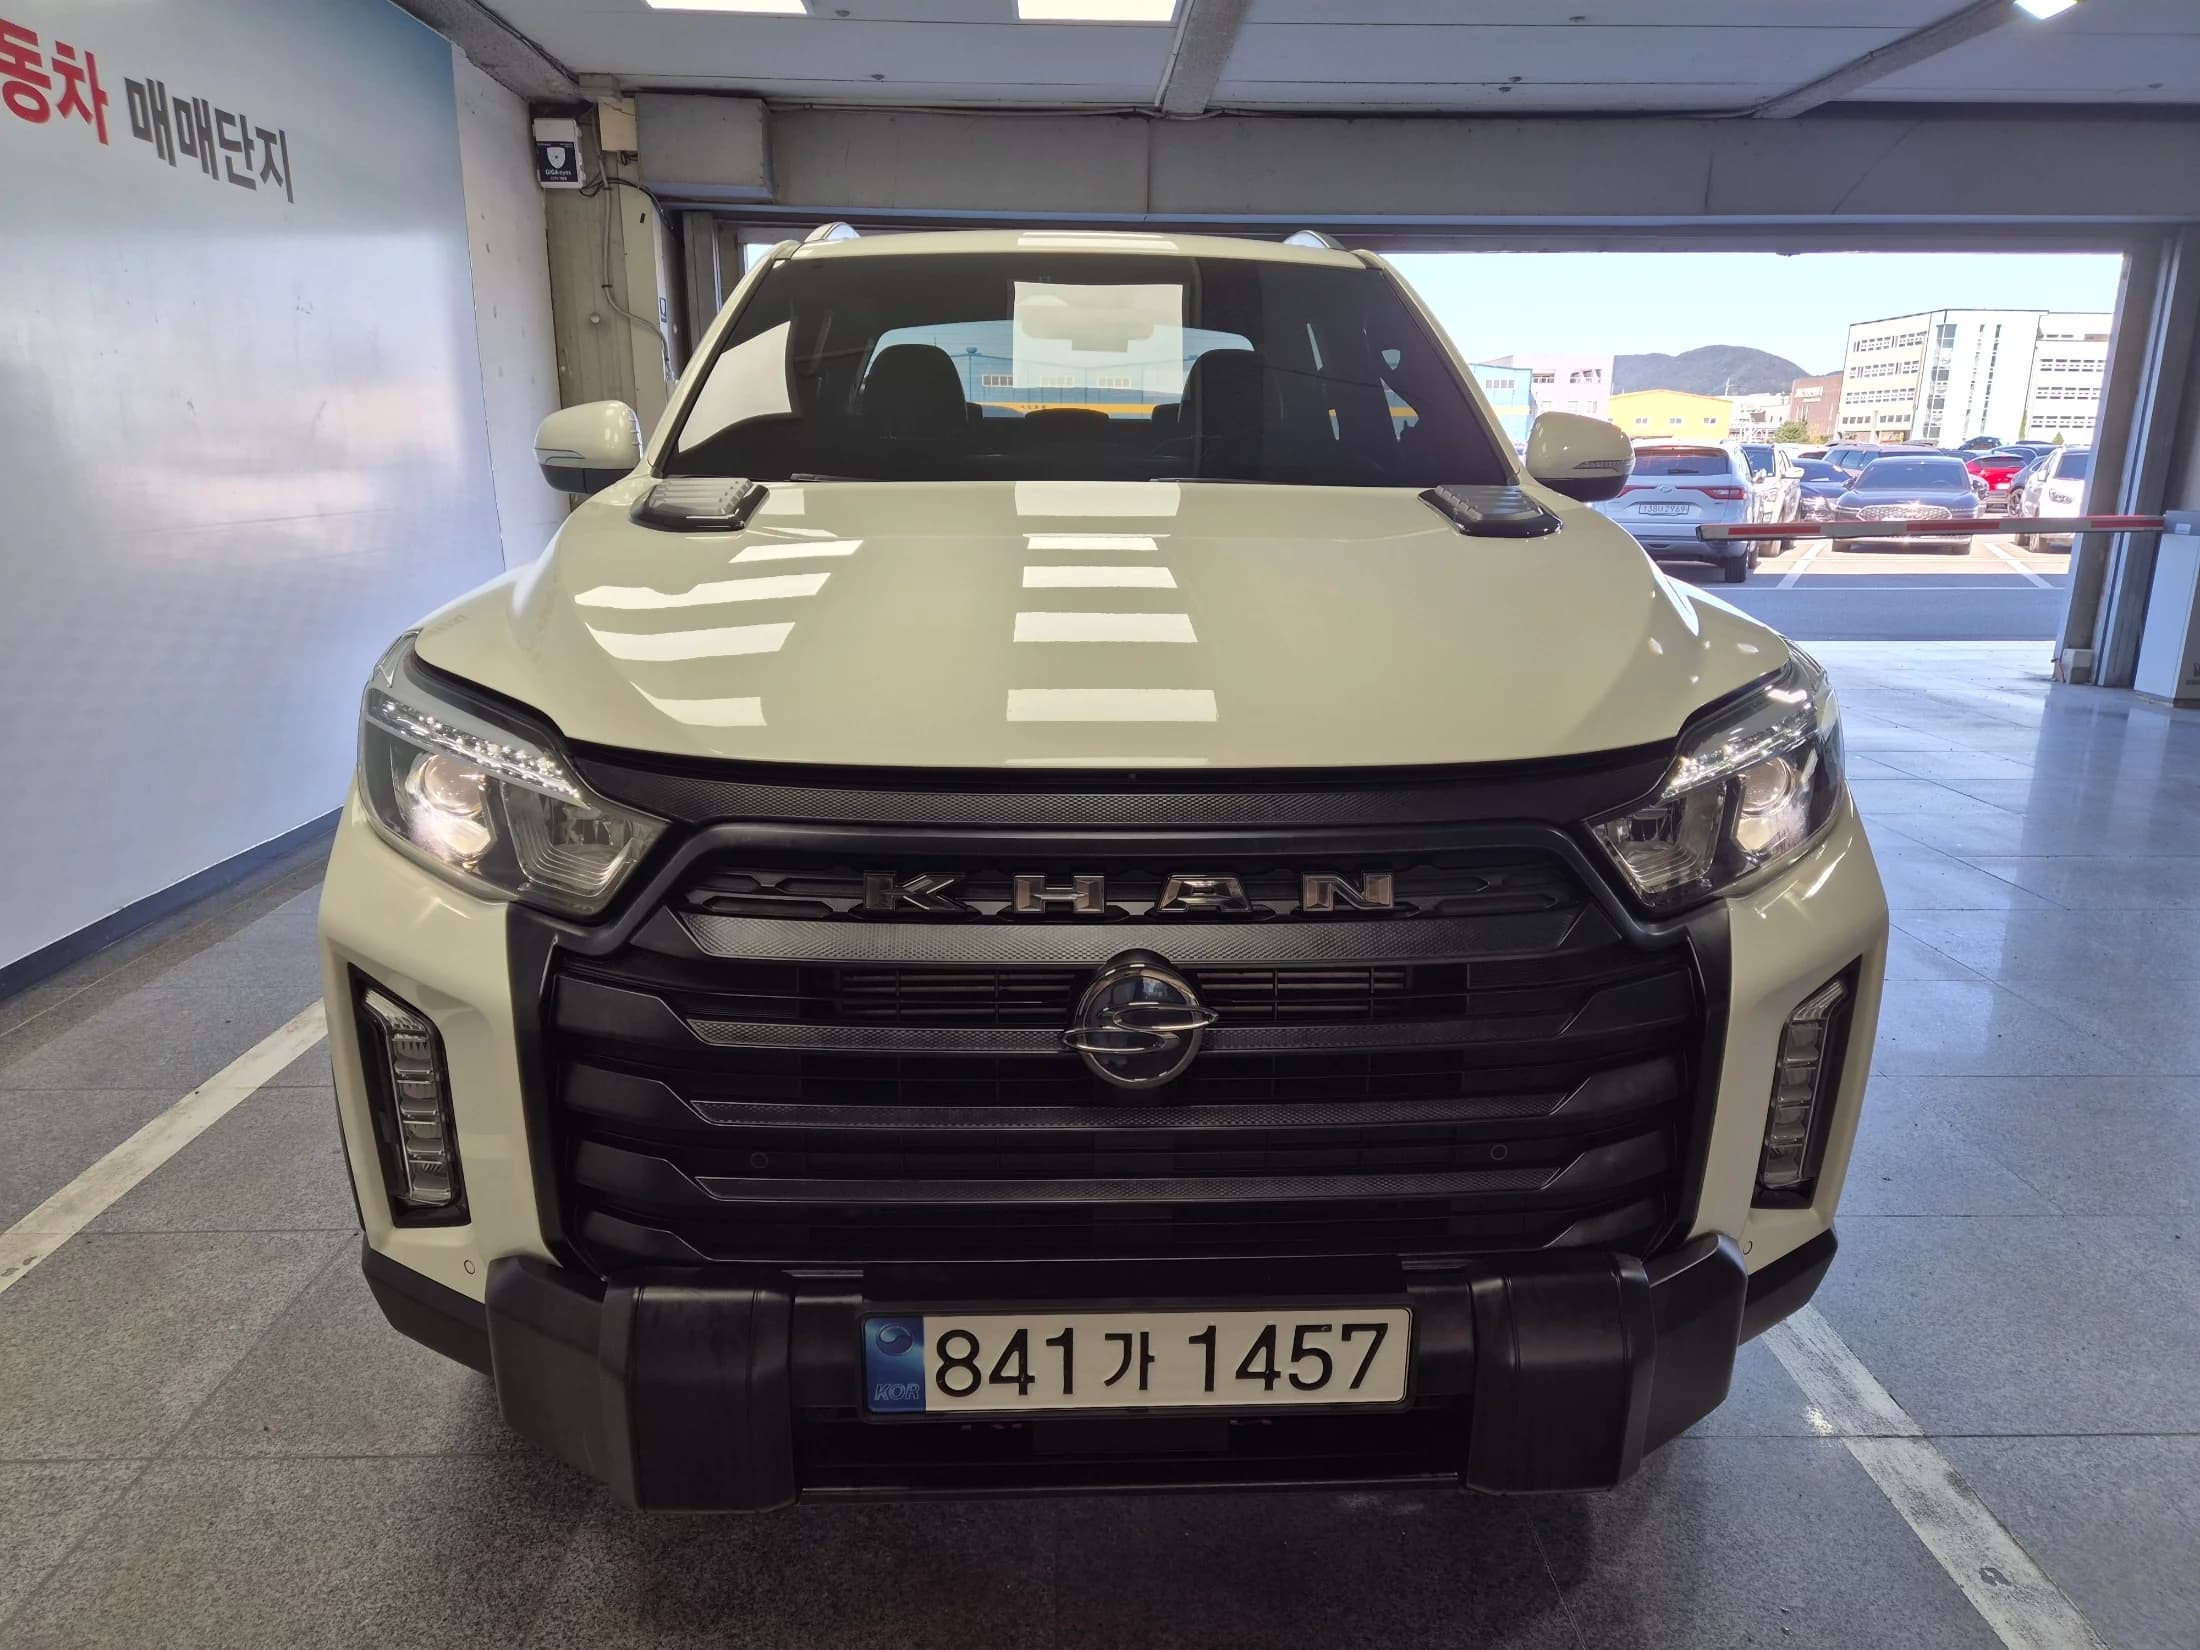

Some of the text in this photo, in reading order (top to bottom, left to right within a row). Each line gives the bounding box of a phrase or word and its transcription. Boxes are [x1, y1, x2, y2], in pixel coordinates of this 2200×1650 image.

[124, 76, 294, 204] 매매단지
[863, 870, 1396, 914] KHAN
[874, 1383, 920, 1400] KOR
